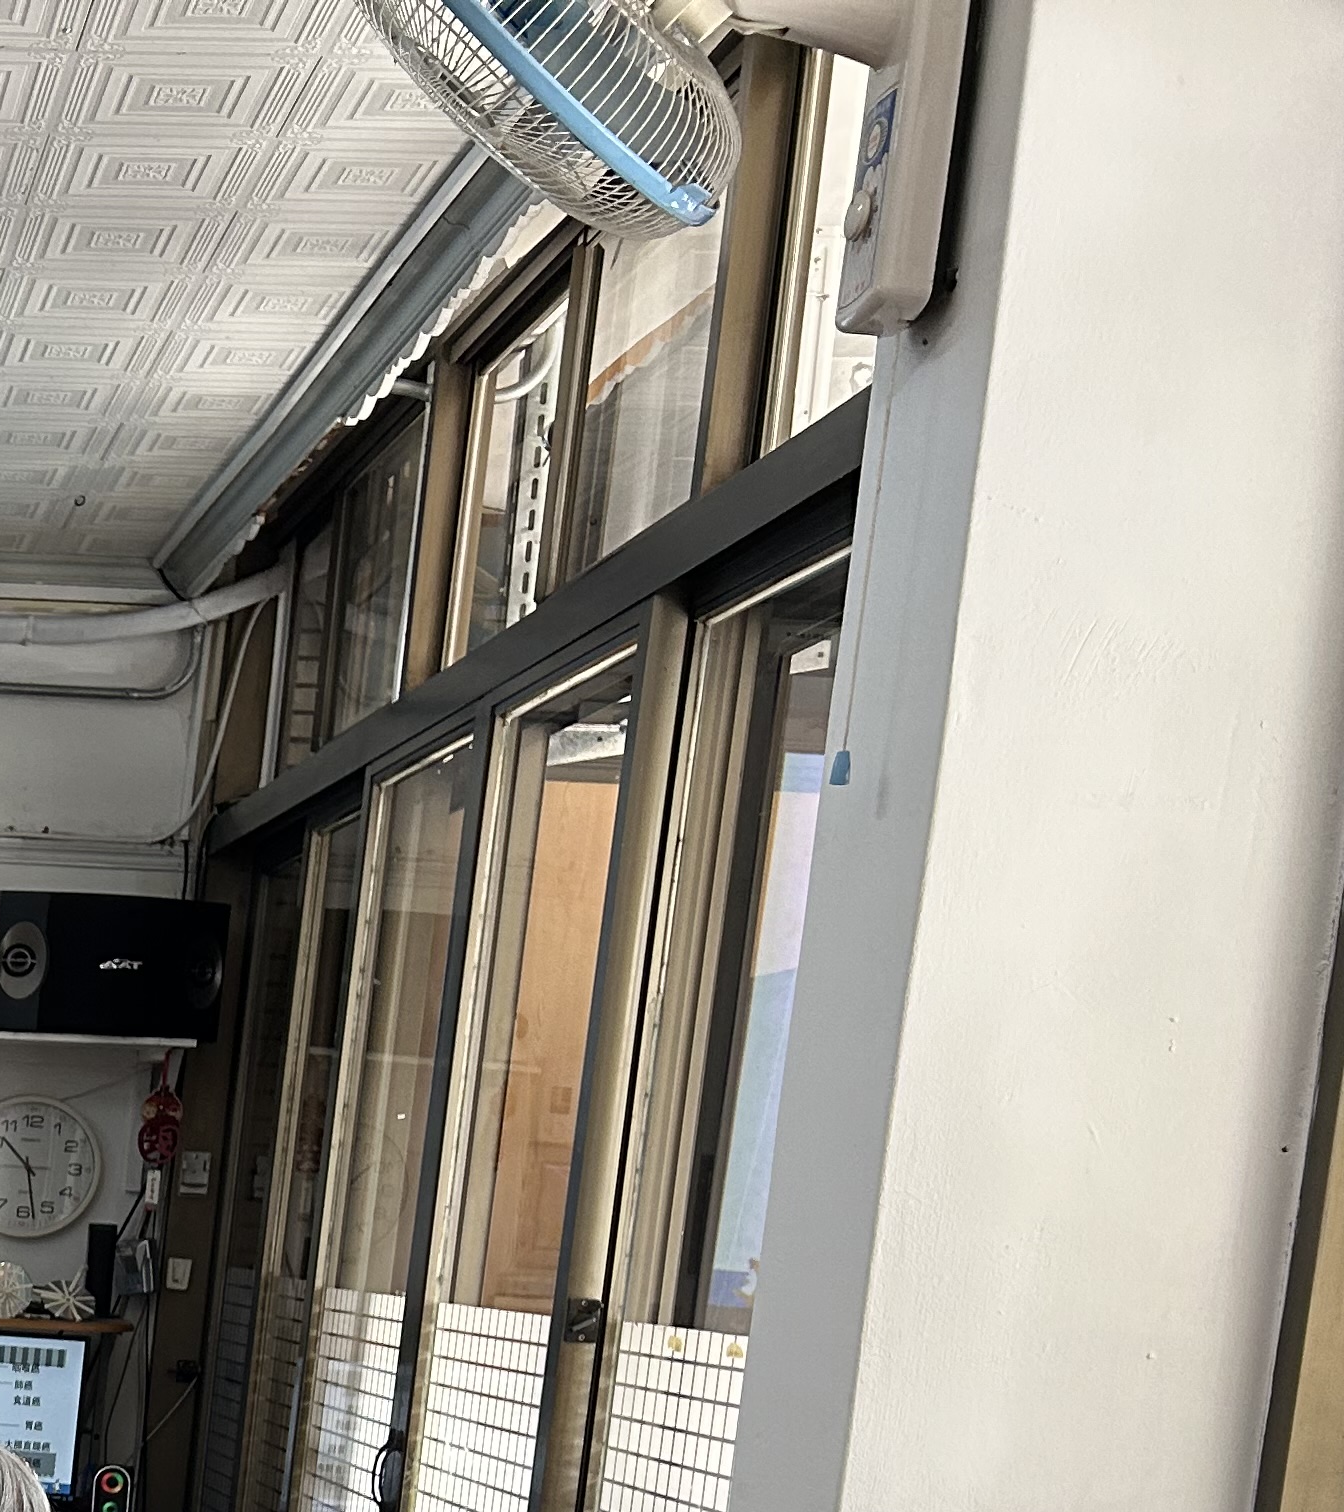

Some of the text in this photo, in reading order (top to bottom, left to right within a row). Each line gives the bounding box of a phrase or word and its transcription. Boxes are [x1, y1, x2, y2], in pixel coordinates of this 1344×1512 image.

[2, 1120, 18, 1132] 11
[22, 1115, 45, 1129] 12
[54, 1122, 62, 1136] 1
[64, 1140, 78, 1153] 2
[68, 1163, 82, 1176] 3
[59, 1186, 73, 1198] 4
[17, 1206, 31, 1218] 6
[40, 1201, 54, 1214] 5
